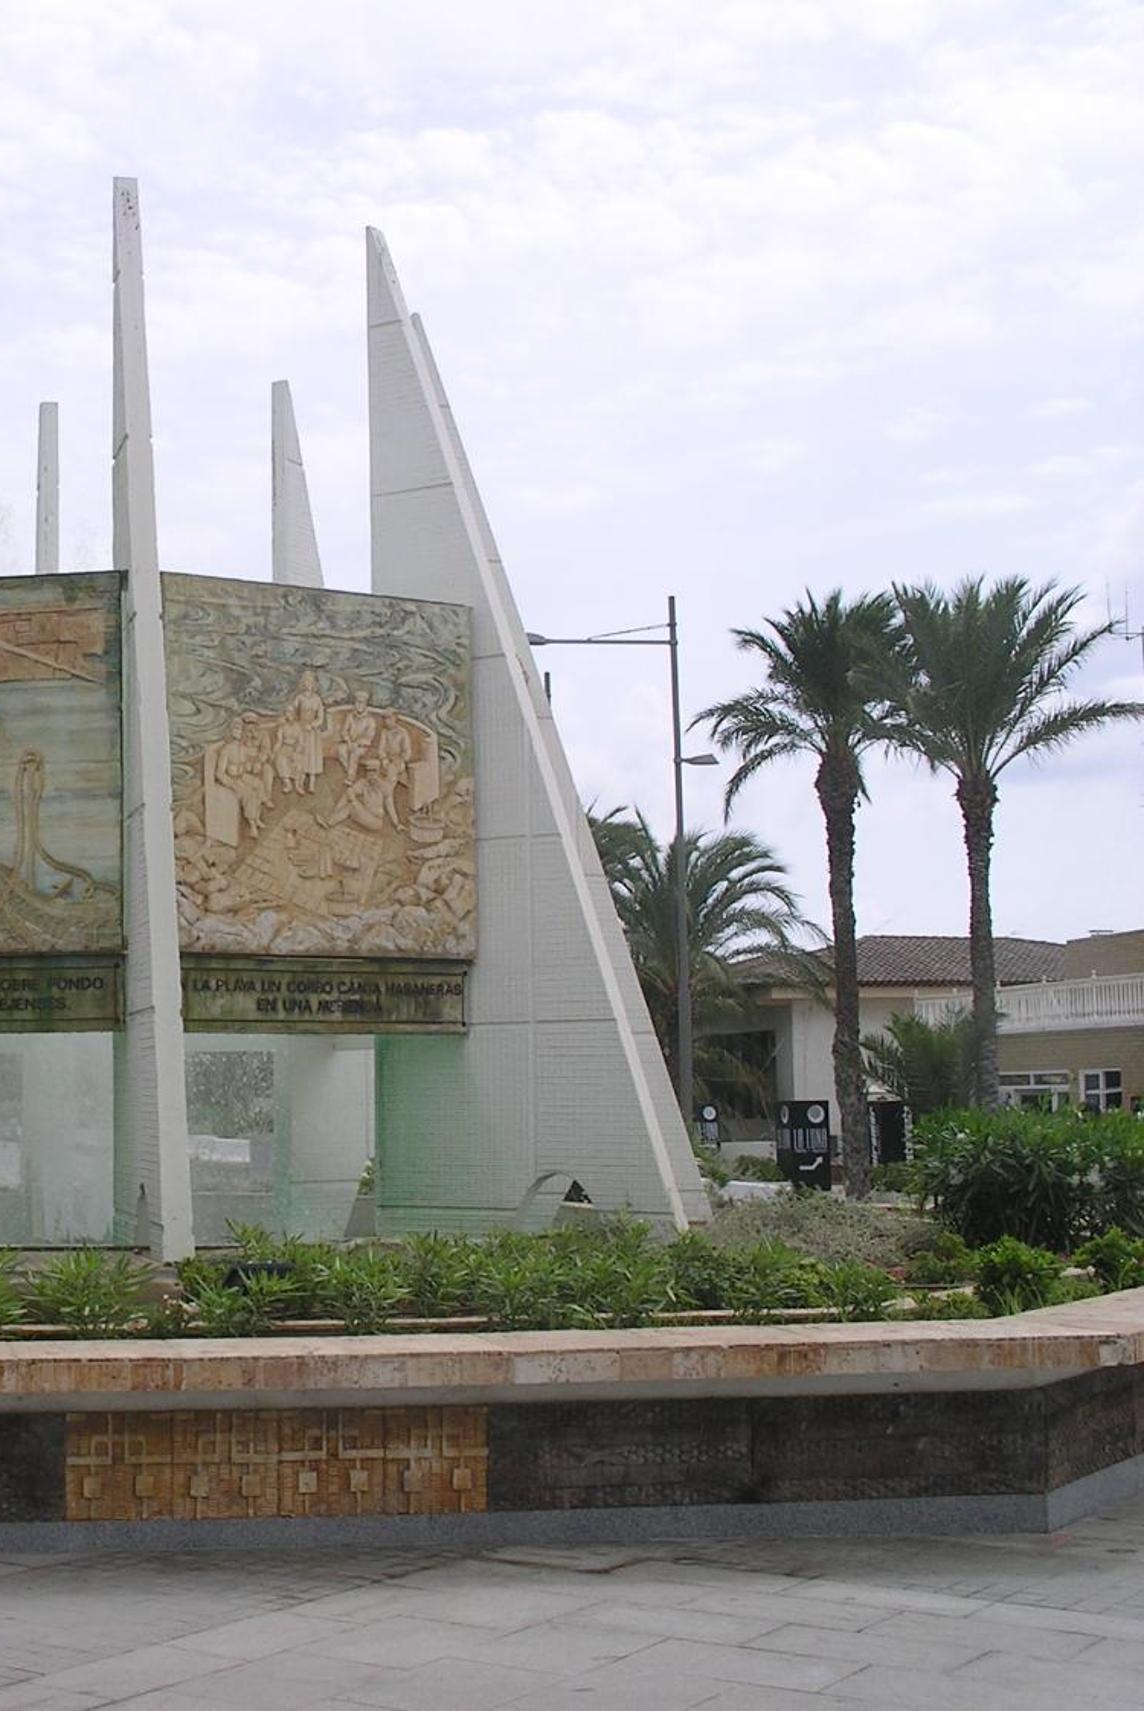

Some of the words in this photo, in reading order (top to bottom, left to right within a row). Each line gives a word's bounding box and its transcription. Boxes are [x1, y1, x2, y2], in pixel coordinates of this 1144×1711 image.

[50, 975, 104, 991] FONDO
[193, 978, 211, 992] LA
[257, 997, 278, 1012] EN
[283, 997, 313, 1014] UNA
